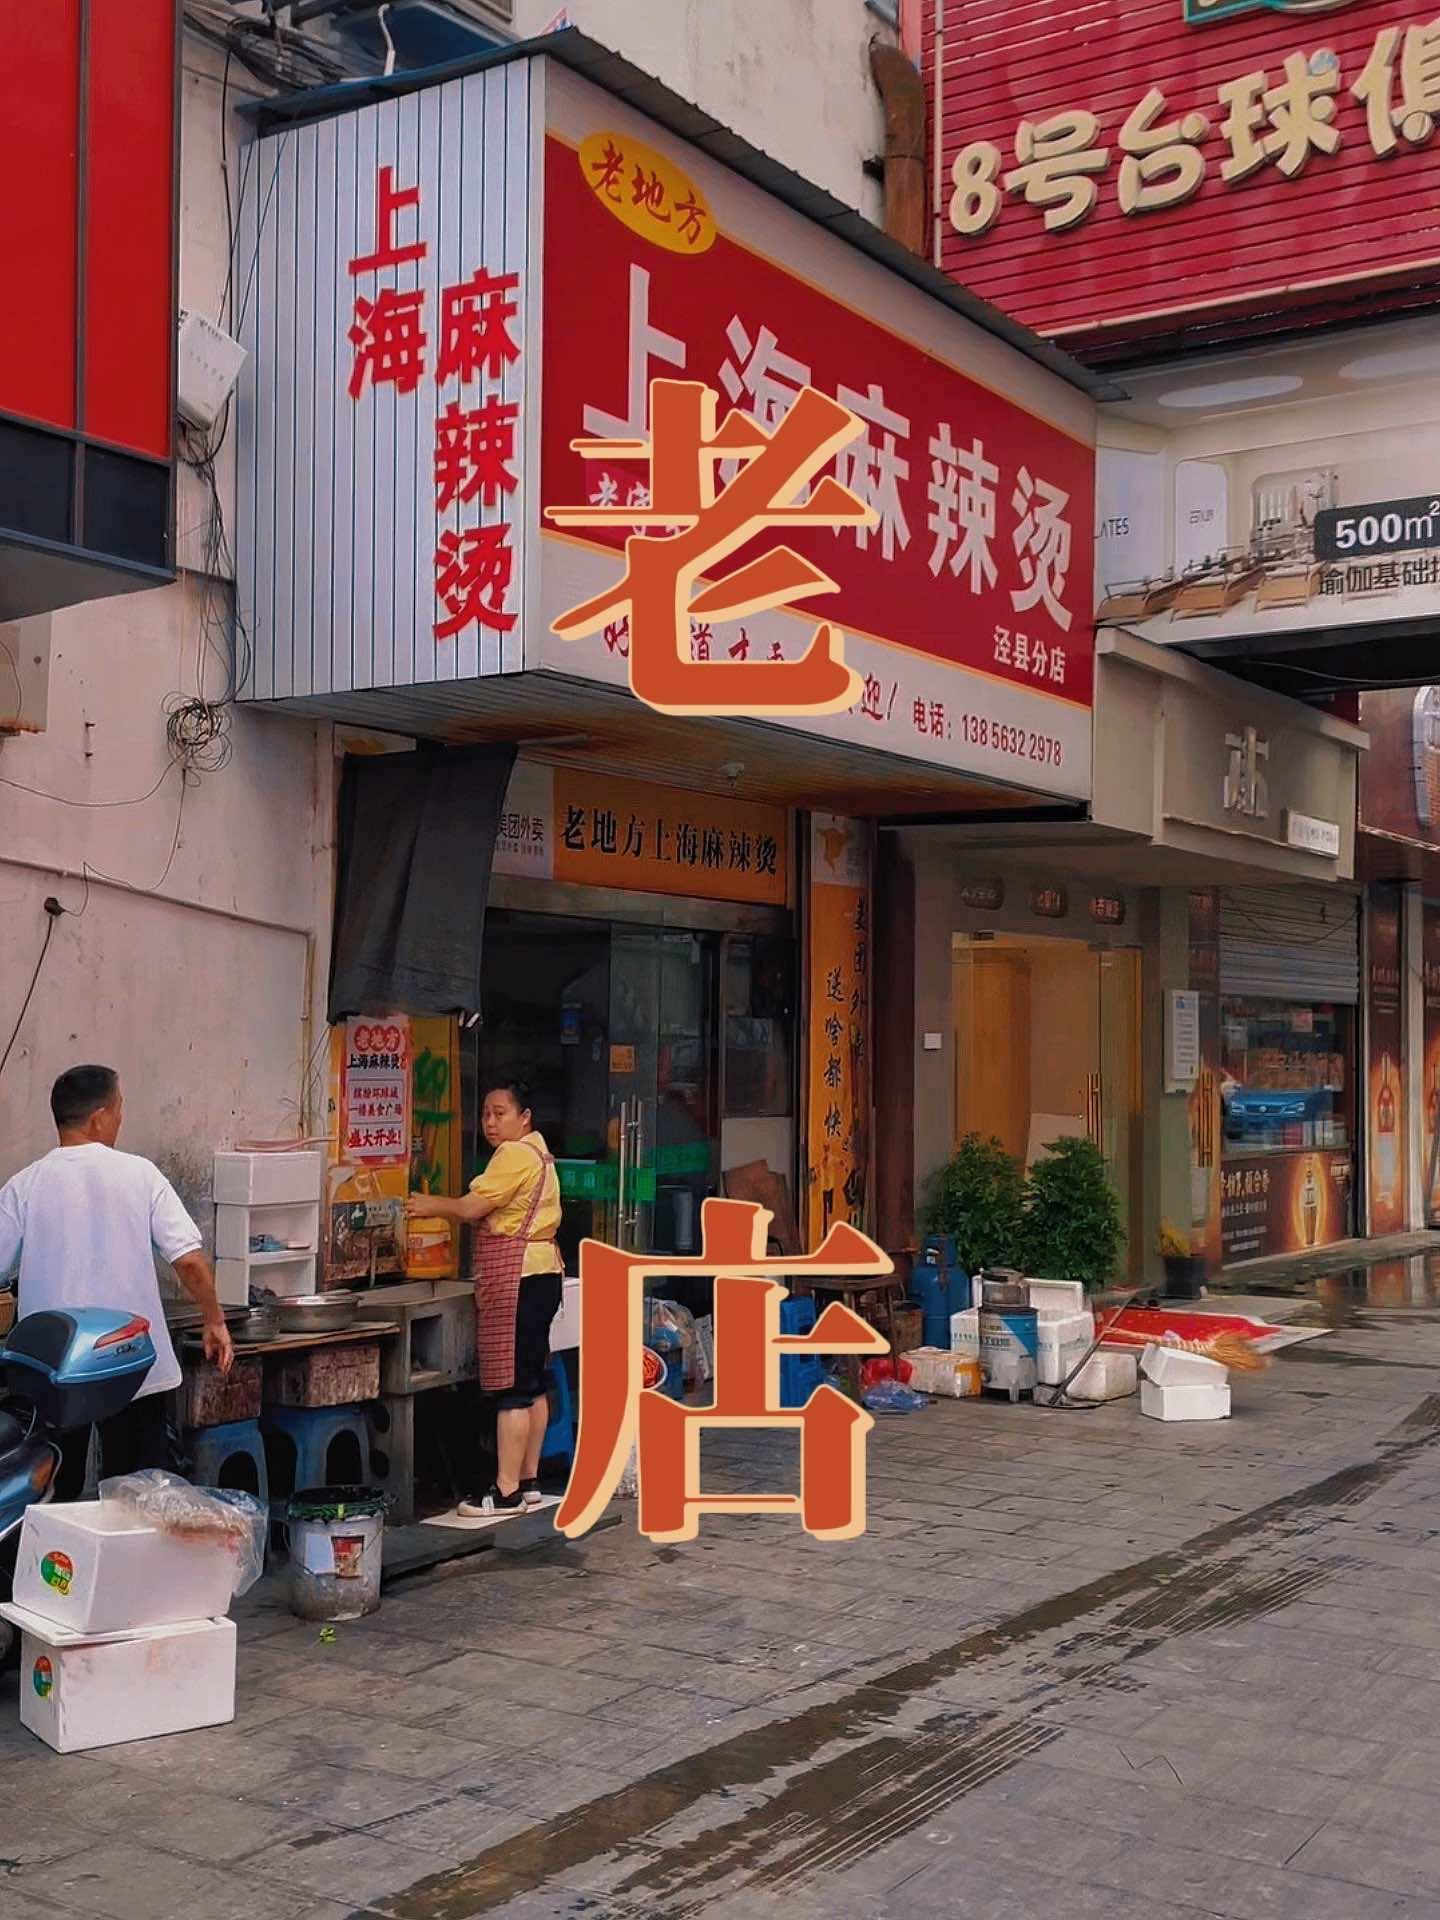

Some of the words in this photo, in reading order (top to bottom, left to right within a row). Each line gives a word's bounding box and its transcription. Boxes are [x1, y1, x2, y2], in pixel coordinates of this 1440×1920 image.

[591, 140, 709, 247] 老地方
[347, 164, 428, 401] 上海
[431, 265, 521, 641] 麻辣烫
[992, 624, 1068, 685] 泾县分店
[559, 803, 778, 877] 老地方上海麻辣烫
